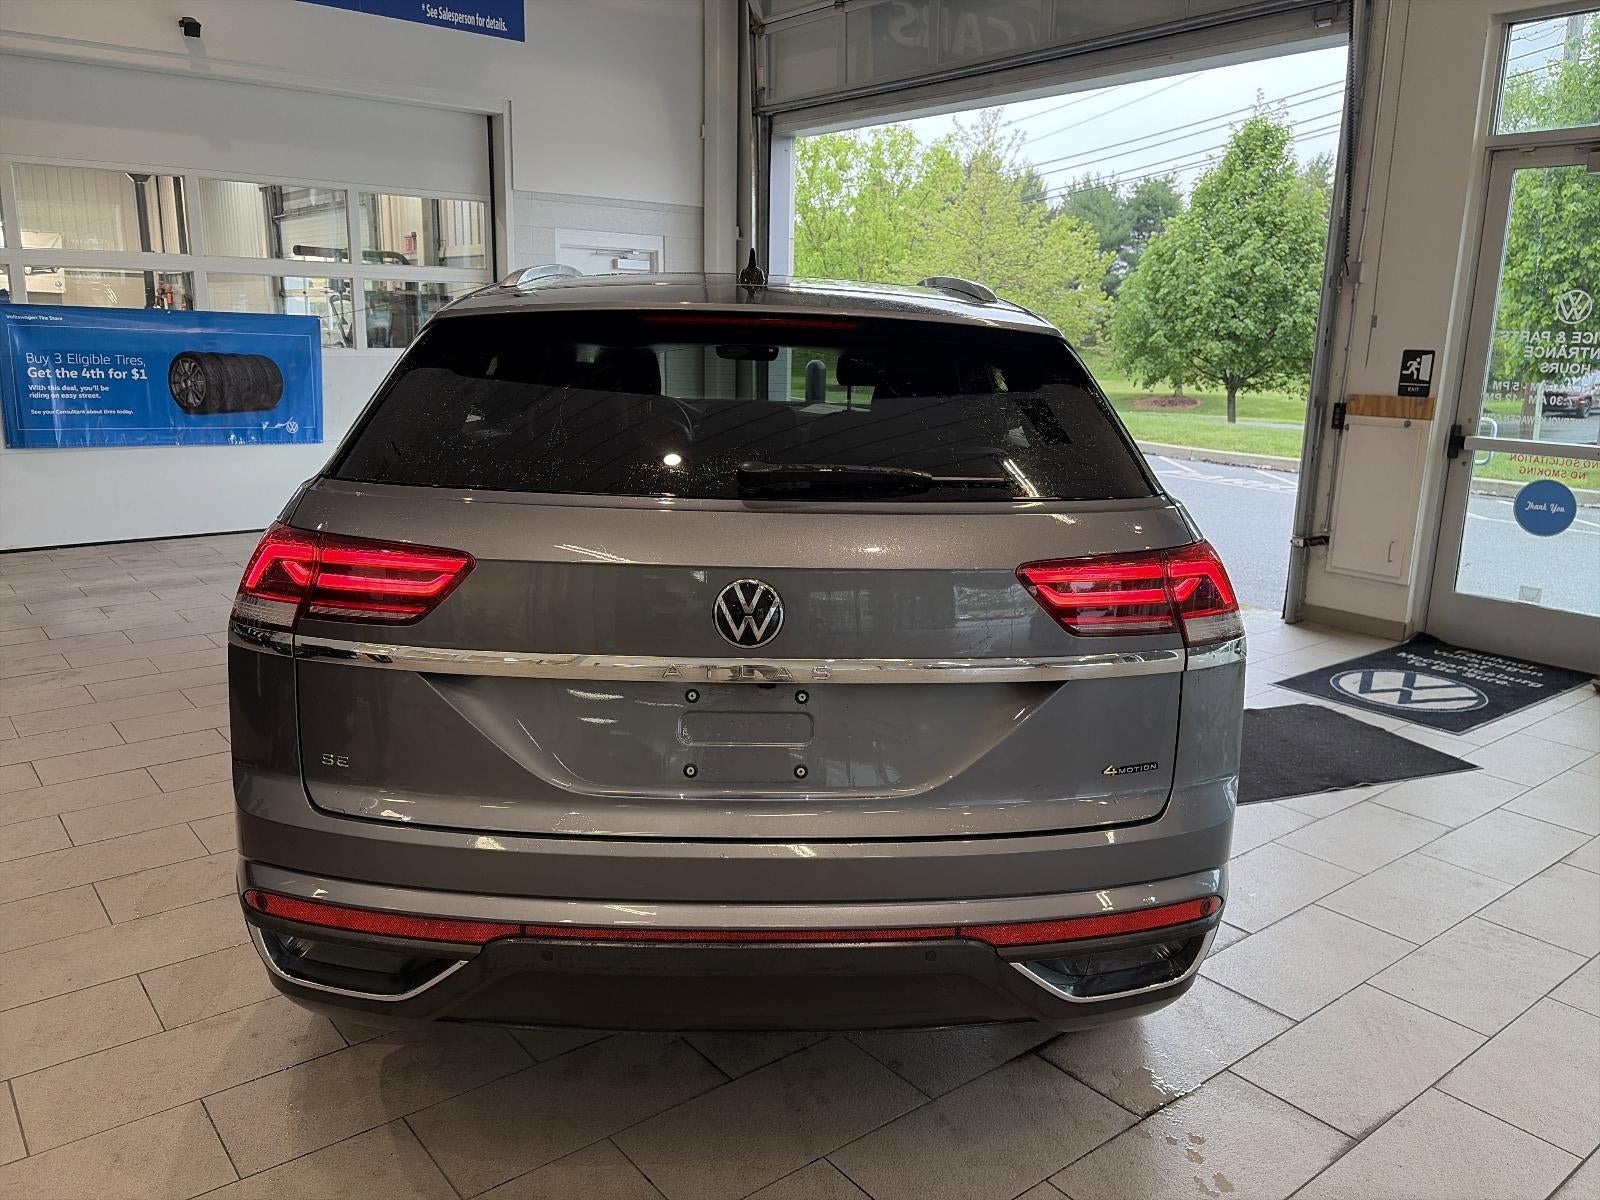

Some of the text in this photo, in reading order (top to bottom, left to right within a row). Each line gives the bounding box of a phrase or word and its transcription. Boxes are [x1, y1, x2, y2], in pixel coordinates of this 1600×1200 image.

[438, 7, 476, 26] Salesperson
[476, 13, 486, 28] for
[485, 15, 508, 32] details.
[25, 352, 146, 368] Buy 3 Eligible Tires,
[27, 366, 148, 381] Get the 4th for $1
[29, 392, 50, 400] riding
[61, 384, 79, 392] deal,
[79, 384, 99, 393] you'll
[1524, 501, 1566, 514] Thank You
[661, 662, 833, 681] ATLAS
[321, 752, 349, 768] SE
[1102, 763, 1158, 777] 4MOTION
